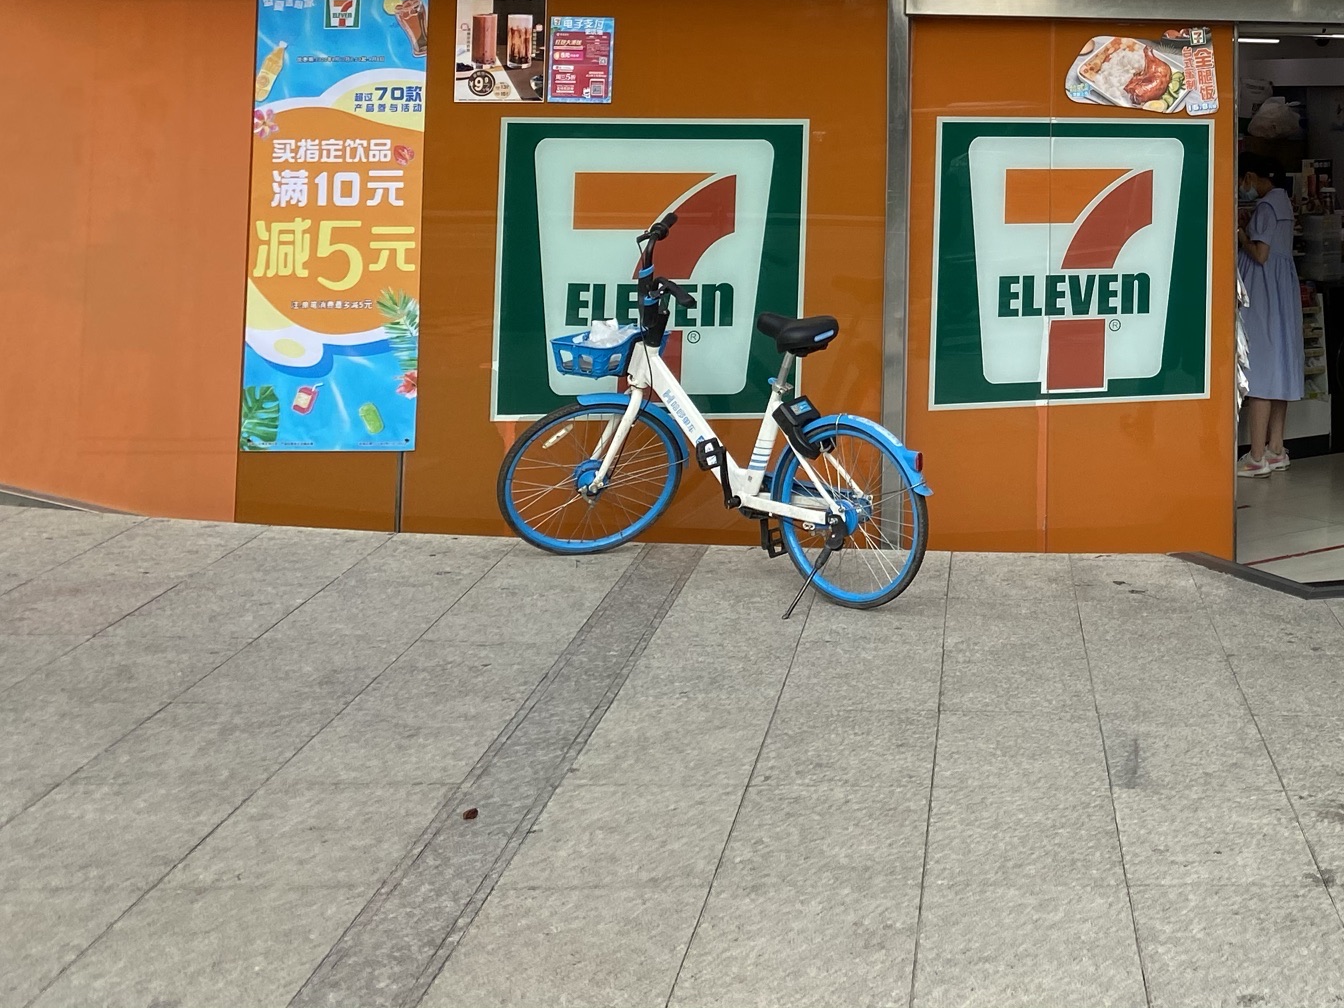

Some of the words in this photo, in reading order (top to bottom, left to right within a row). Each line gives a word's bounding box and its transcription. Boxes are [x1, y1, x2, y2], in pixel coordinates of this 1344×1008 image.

[271, 169, 404, 207] 满10元
[272, 139, 391, 163] 买指定饮品
[253, 217, 416, 291] 减5元
[572, 172, 737, 402] 7
[1004, 169, 1154, 390] 7
